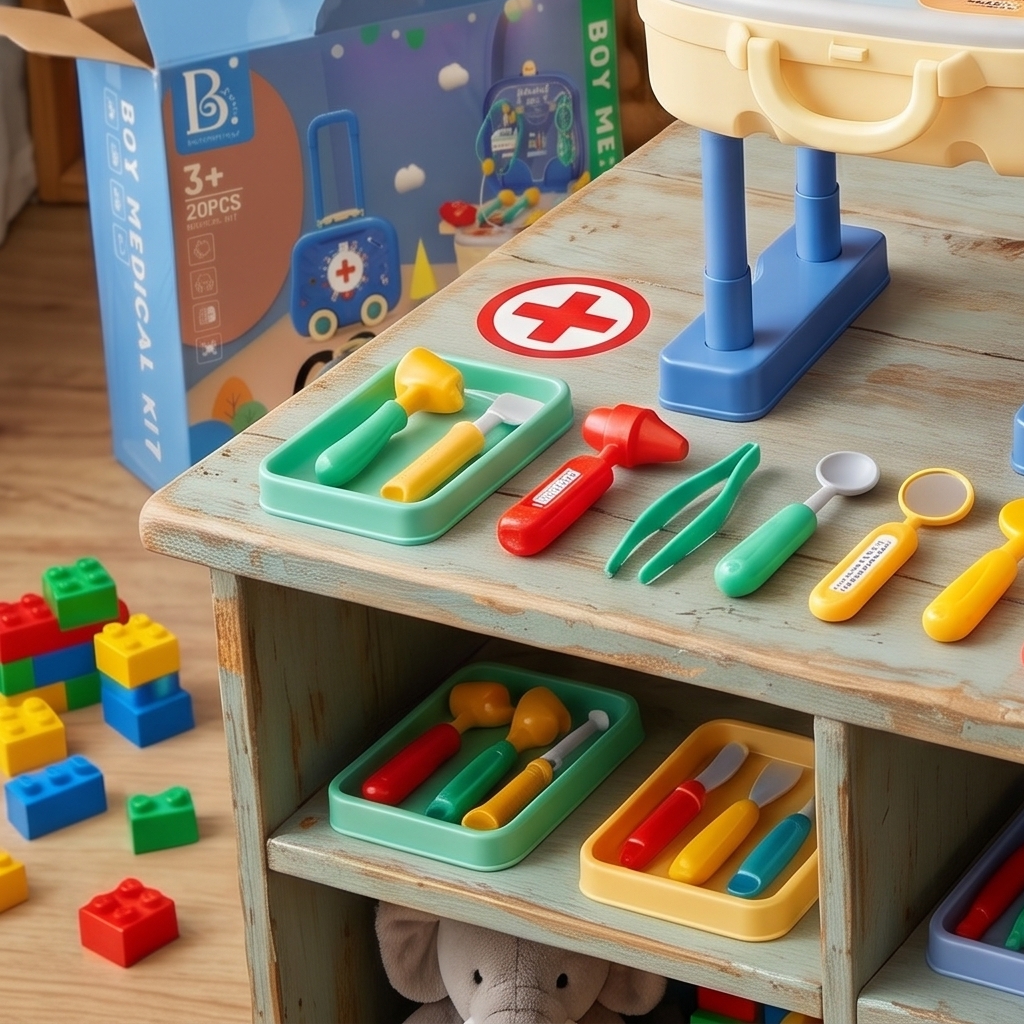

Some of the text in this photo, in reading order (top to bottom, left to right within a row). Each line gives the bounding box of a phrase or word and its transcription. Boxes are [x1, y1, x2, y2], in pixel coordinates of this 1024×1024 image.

[587, 19, 616, 167] BOY ME
[183, 163, 224, 196] 3+
[186, 193, 242, 221] 20PCS
[120, 98, 163, 464] BOY MEDICAL KIT
